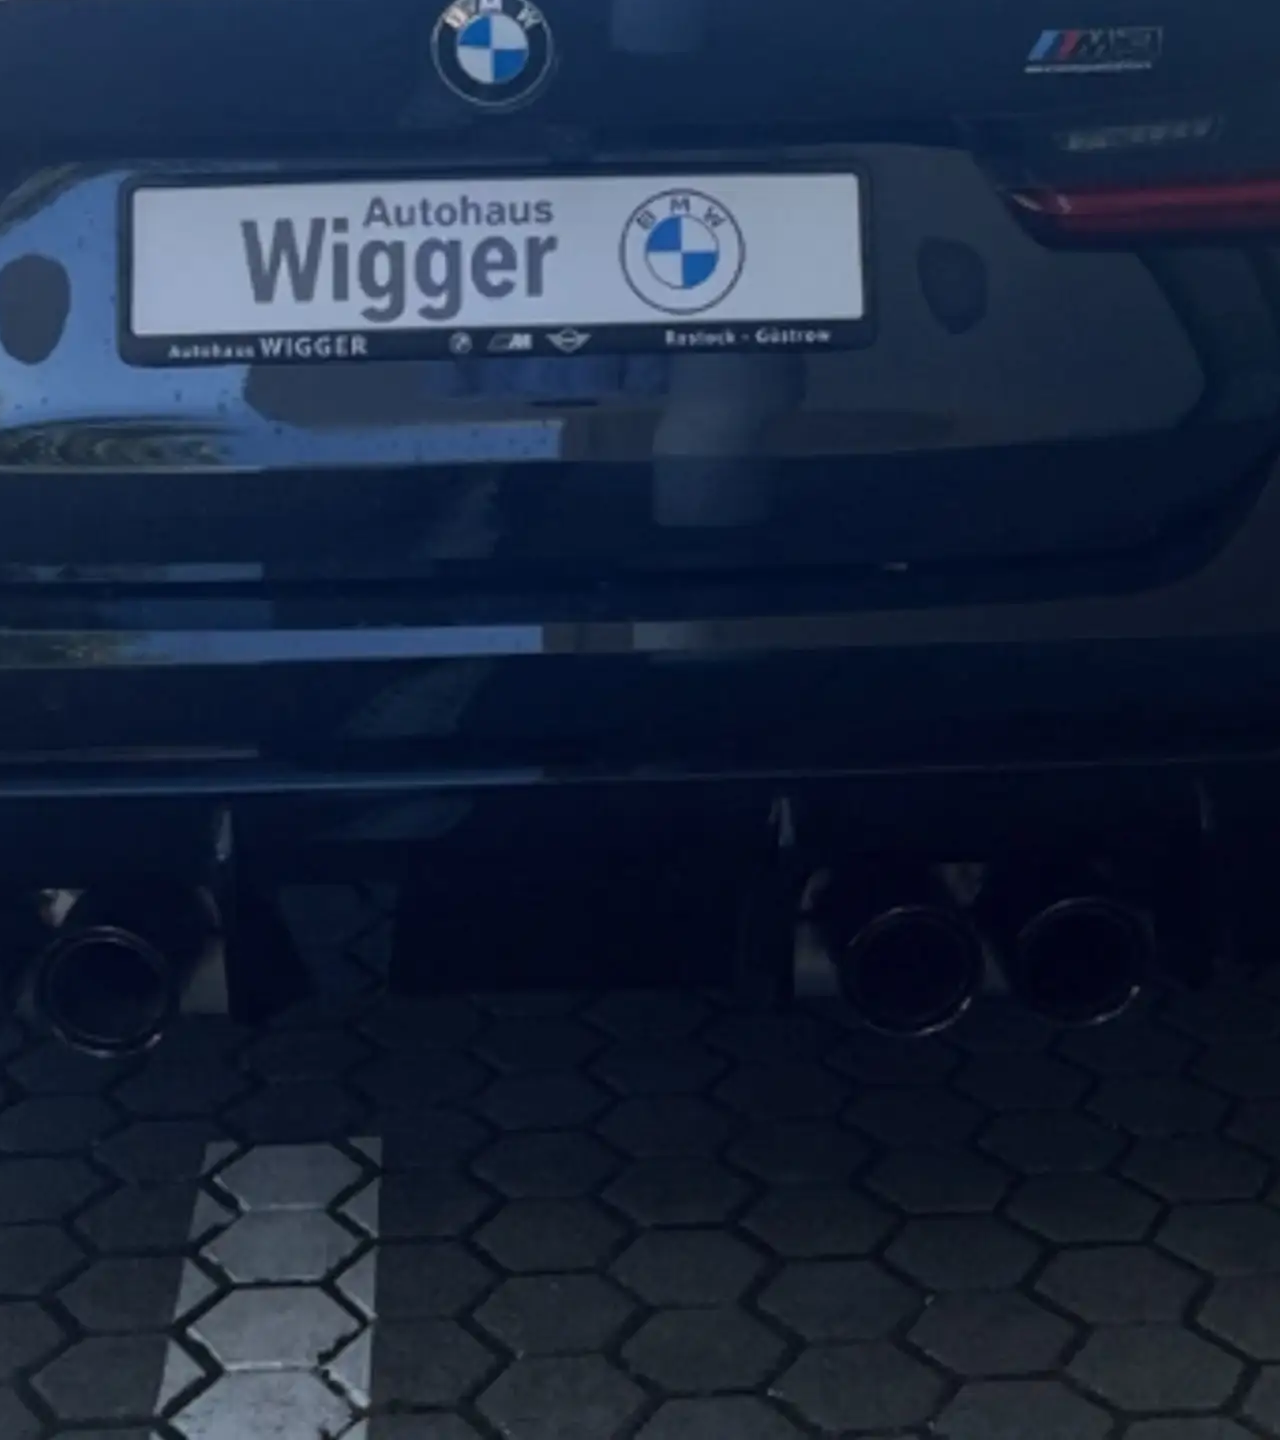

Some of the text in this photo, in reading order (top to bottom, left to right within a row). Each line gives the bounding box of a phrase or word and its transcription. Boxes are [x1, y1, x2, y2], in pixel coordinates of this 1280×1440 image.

[363, 195, 554, 228] Autohaus
[636, 196, 727, 230] BMW
[240, 217, 558, 323] Wigger
[258, 334, 367, 357] WIGGER
